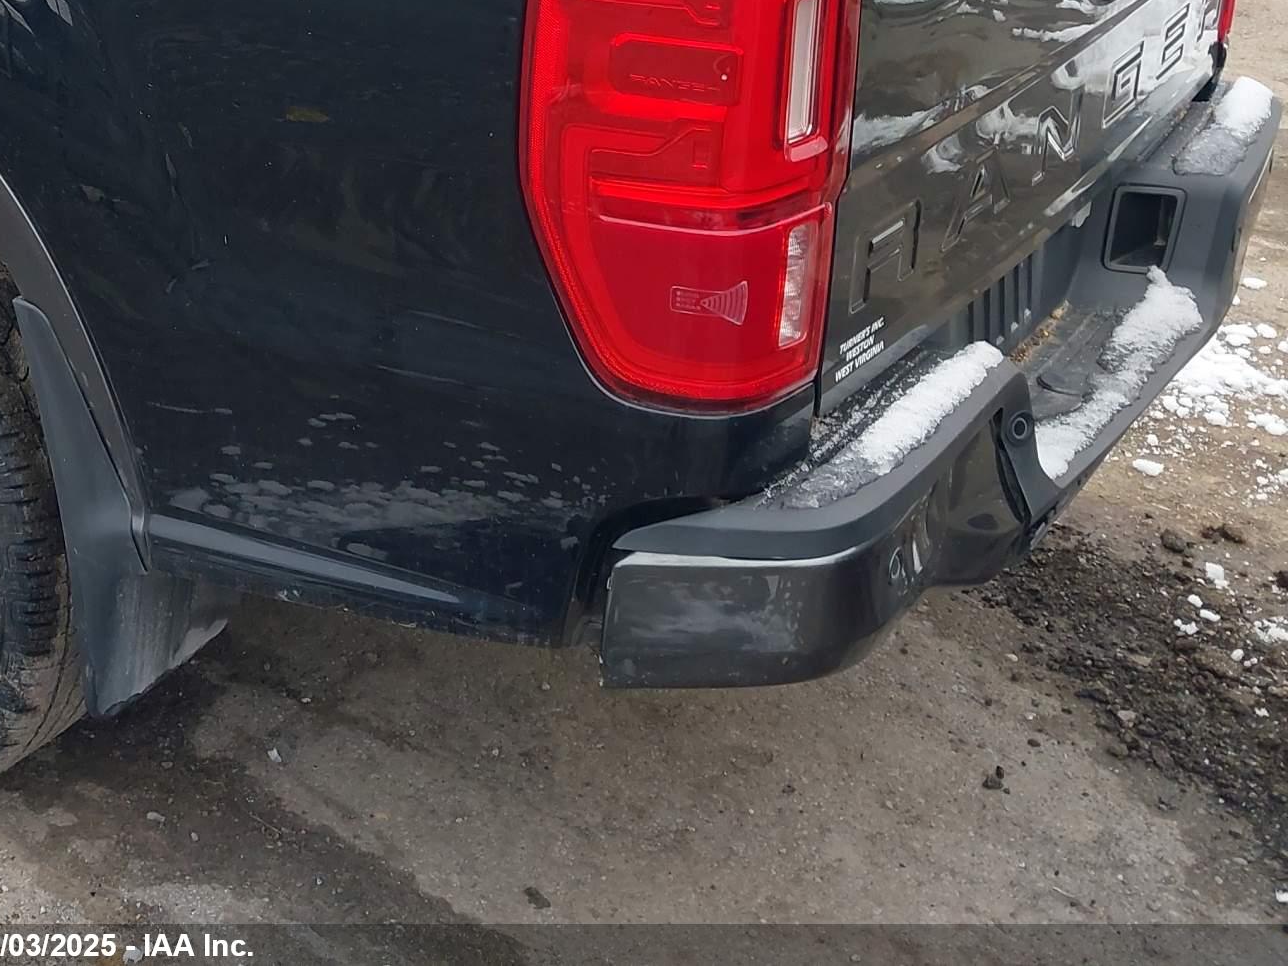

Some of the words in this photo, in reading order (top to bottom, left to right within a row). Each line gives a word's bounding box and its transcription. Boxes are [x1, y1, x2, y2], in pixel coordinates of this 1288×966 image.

[835, 361, 854, 383] WEST
[854, 340, 885, 369] VIRGINIA
[845, 334, 875, 362] WESTON
